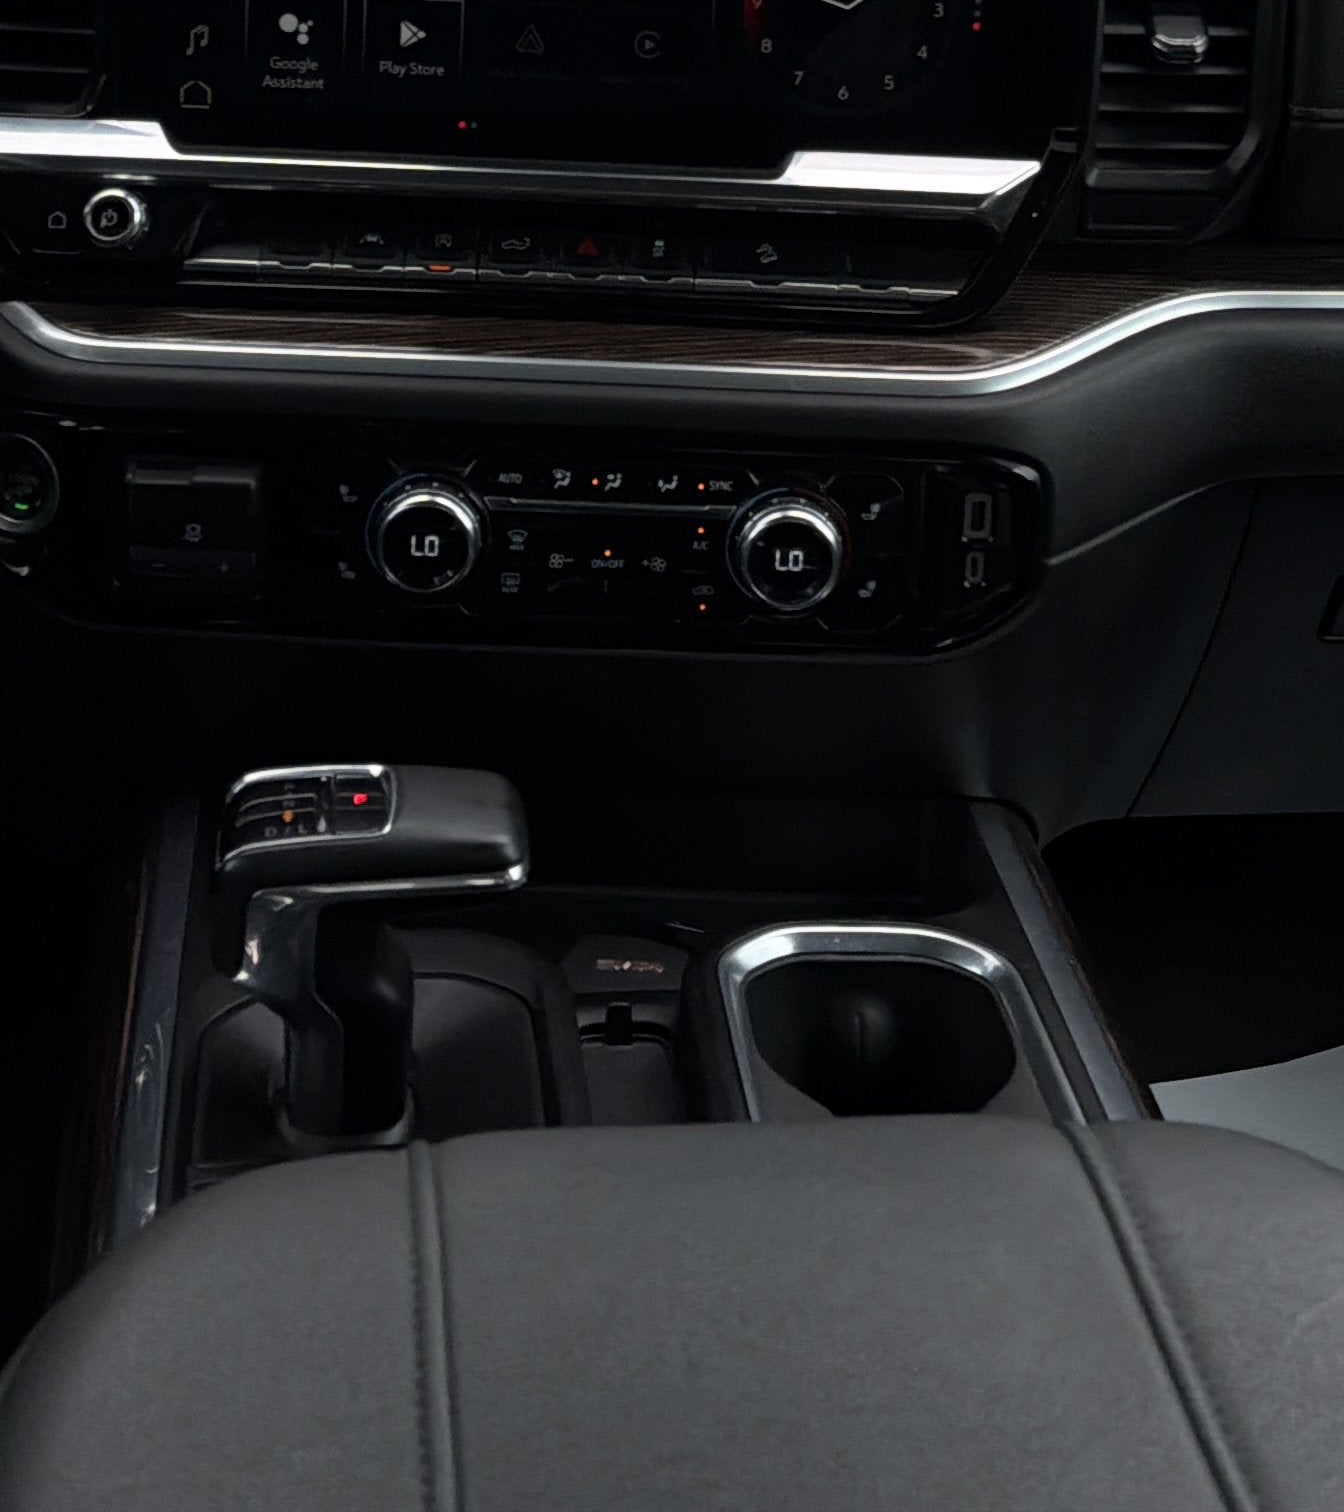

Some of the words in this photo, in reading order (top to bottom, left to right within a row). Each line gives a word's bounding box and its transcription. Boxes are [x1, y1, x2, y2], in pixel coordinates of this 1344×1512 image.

[933, 2, 945, 18] 3
[760, 39, 773, 54] 8
[916, 45, 929, 61] 4
[269, 56, 319, 74] Google
[379, 60, 408, 78] Play
[409, 62, 446, 76] Store
[261, 75, 325, 89] Assistant
[794, 71, 804, 85] 7
[884, 75, 895, 90] 5
[838, 86, 849, 100] 6
[709, 480, 734, 492] SYNC
[410, 534, 439, 557] LO
[775, 549, 804, 572] LO
